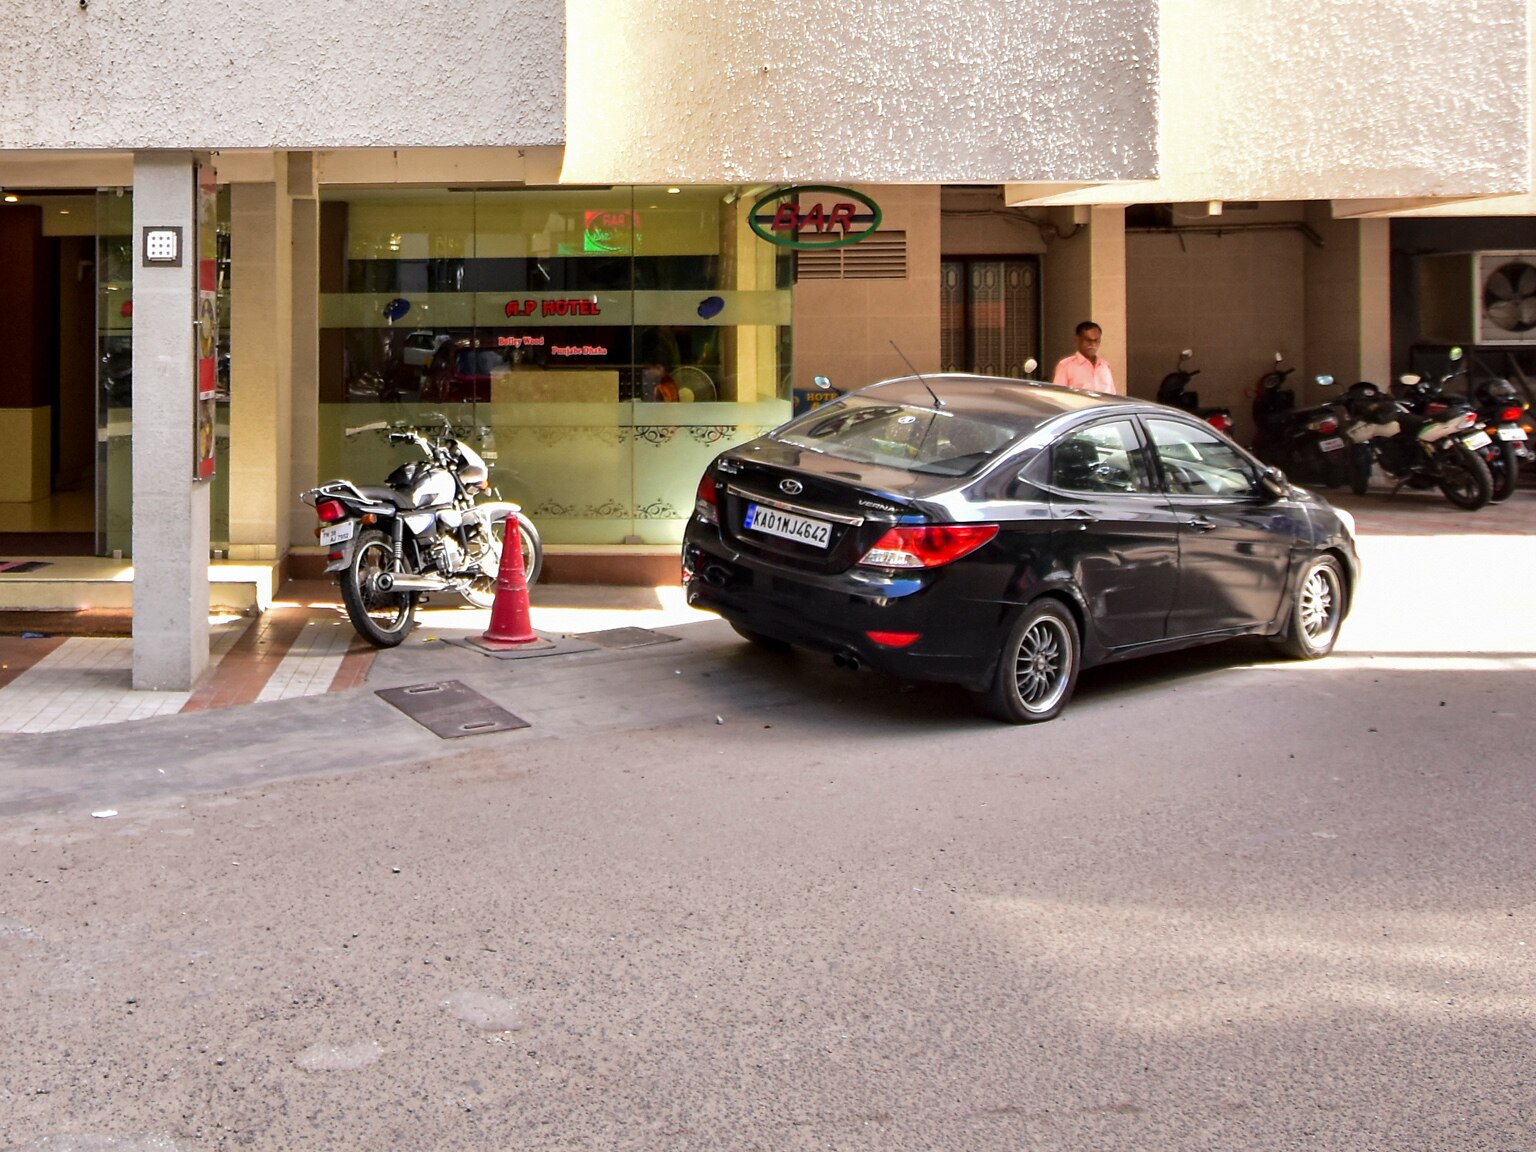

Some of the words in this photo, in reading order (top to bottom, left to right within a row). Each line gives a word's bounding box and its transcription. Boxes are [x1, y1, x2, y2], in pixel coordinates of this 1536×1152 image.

[771, 203, 856, 234] BAR
[542, 300, 601, 318] HOTEL
[522, 336, 545, 346] Wood
[807, 392, 839, 401] HOTE
[858, 500, 895, 512] VERNA
[753, 509, 828, 543] KA01MJ4642
